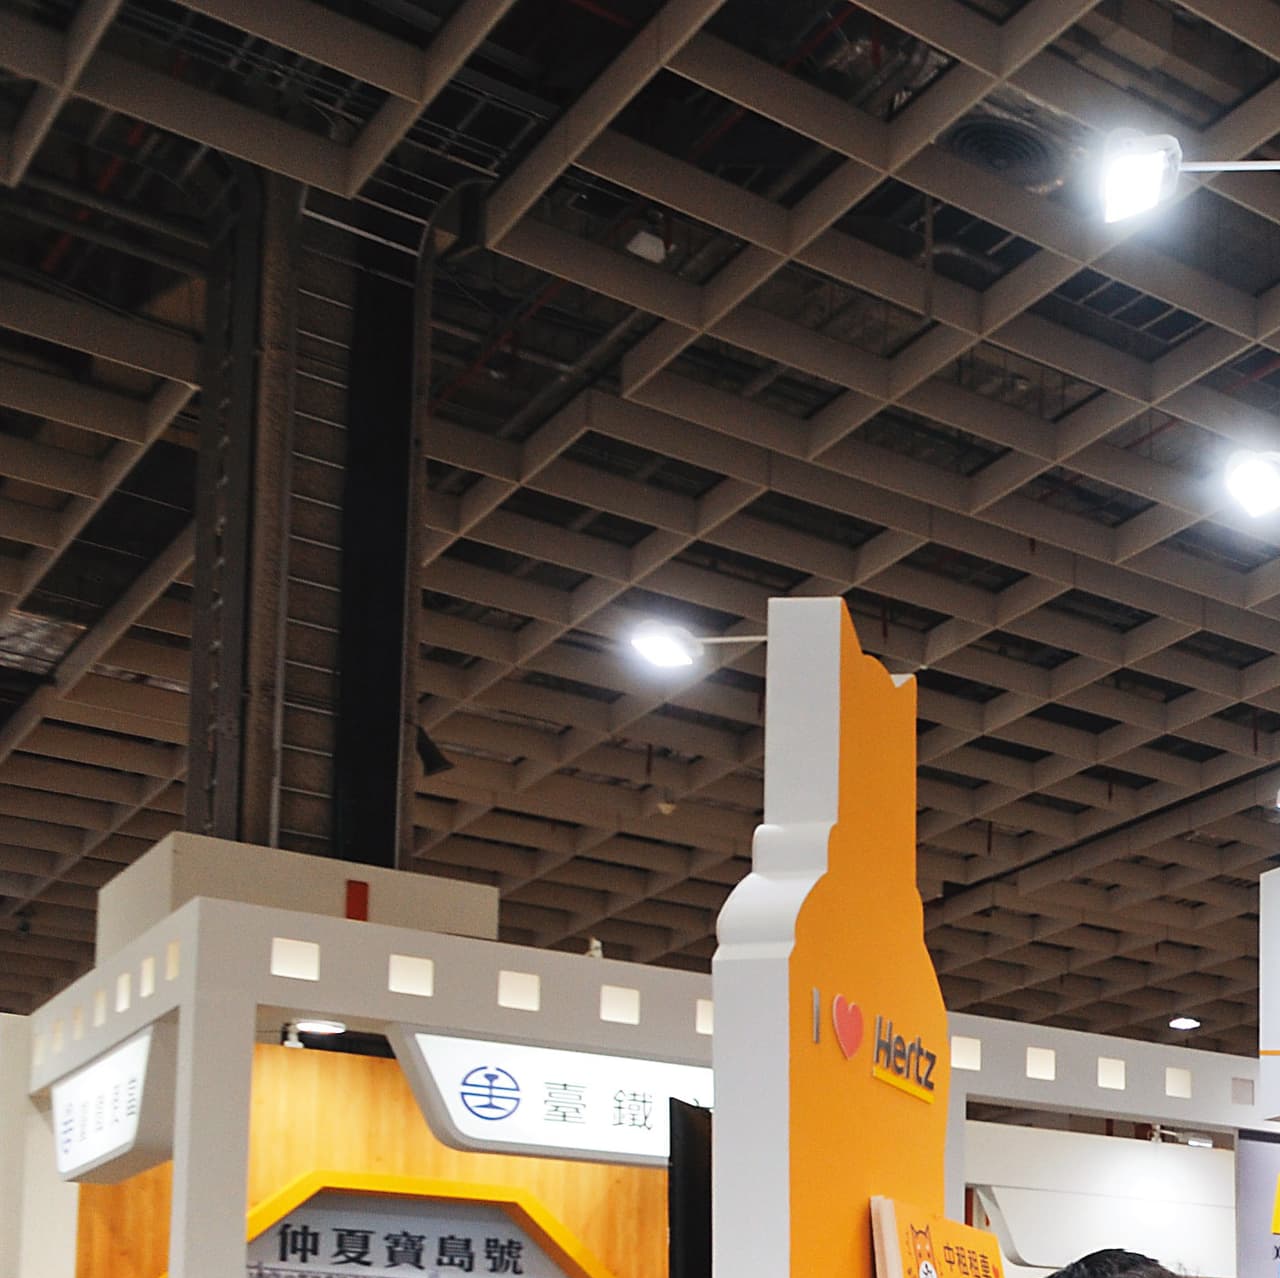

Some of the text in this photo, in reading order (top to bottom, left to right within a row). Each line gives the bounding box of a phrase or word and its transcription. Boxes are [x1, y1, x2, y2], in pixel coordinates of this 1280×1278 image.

[874, 1014, 936, 1092] Hertz
[278, 1223, 525, 1275] 仲夏寶島號
